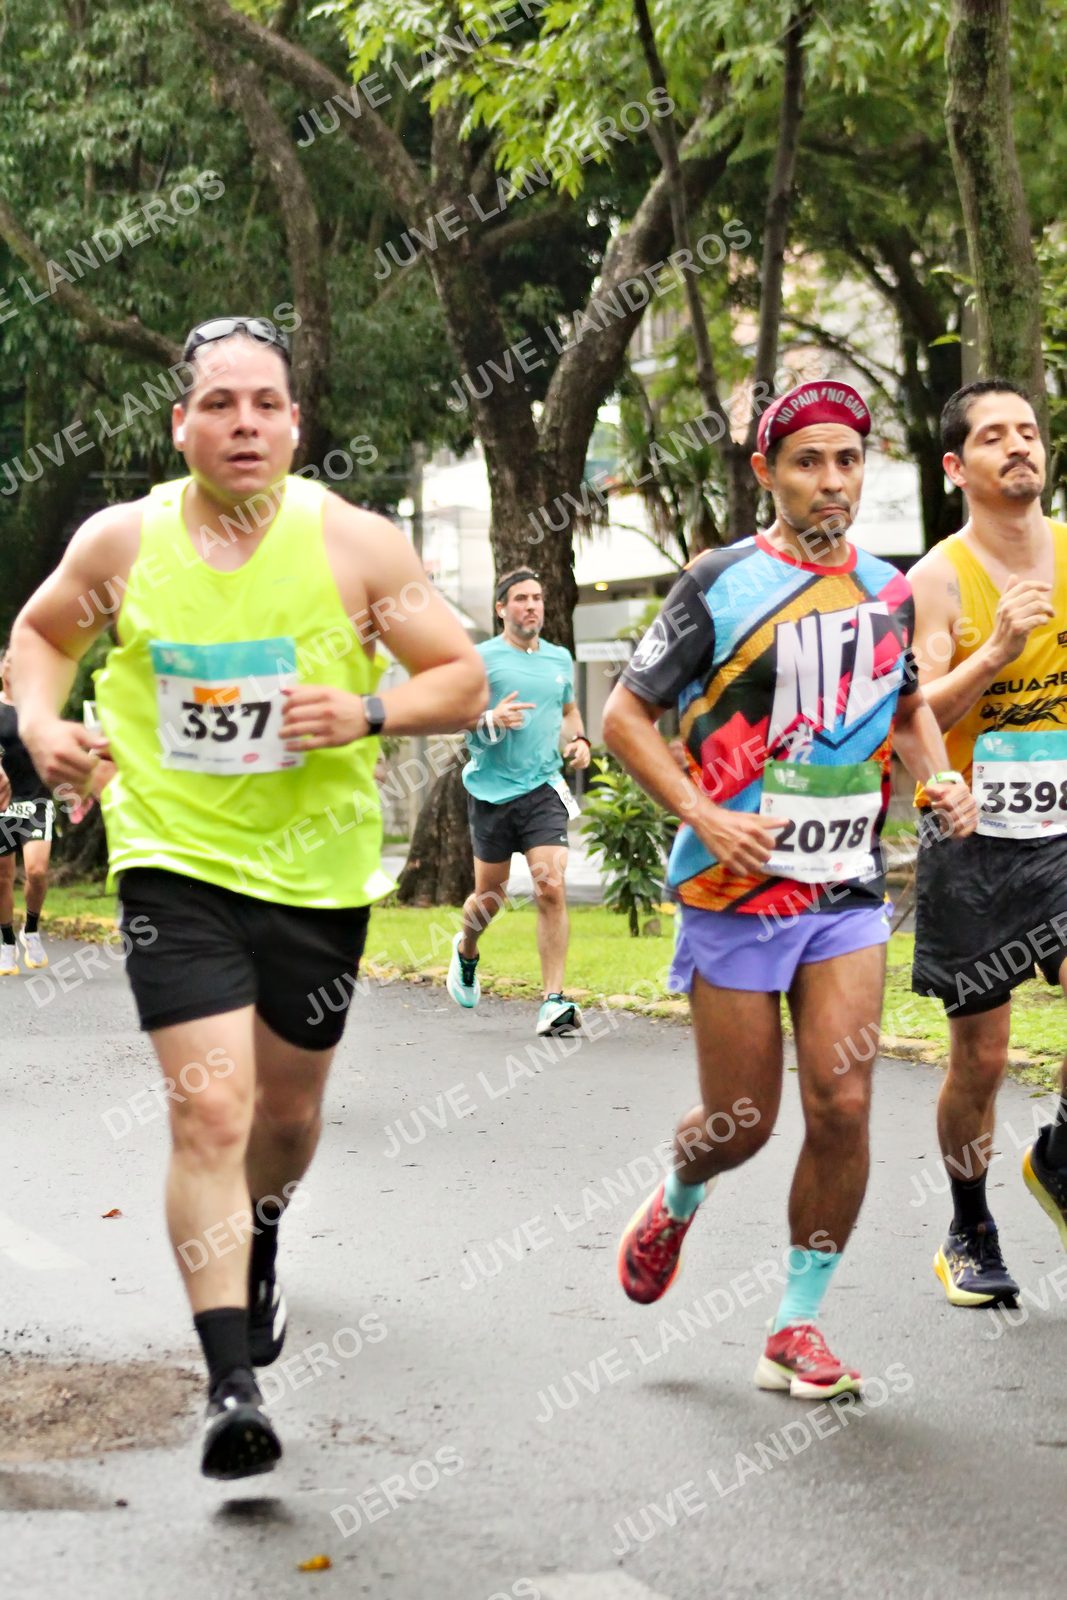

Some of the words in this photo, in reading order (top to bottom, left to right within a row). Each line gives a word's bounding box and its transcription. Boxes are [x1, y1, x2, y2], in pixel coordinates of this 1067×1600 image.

[776, 407, 795, 424] NO
[790, 389, 819, 411] PAIN
[844, 395, 867, 420] GAIN
[181, 701, 272, 743] 337
[774, 816, 869, 854] 2078
